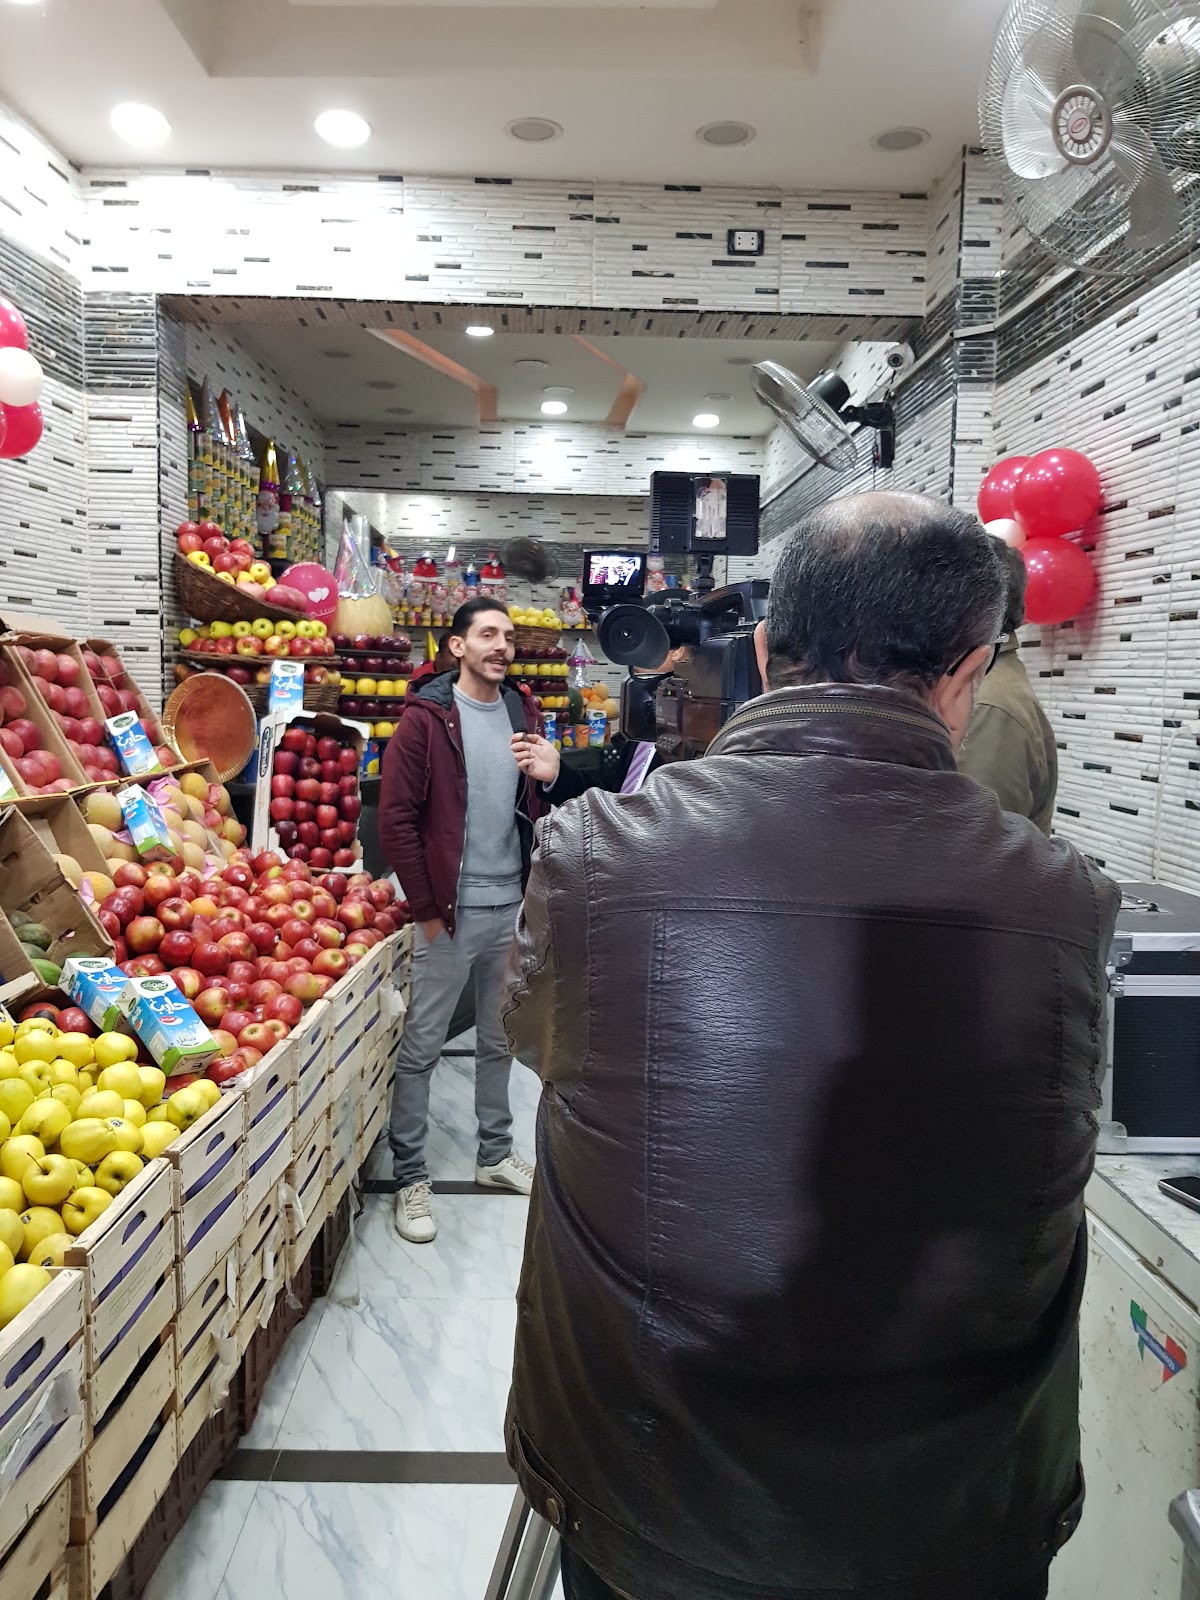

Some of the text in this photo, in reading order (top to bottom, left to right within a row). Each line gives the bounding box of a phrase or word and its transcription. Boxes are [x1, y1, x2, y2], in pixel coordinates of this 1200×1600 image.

[275, 677, 303, 690] حليب
[117, 730, 147, 749] حليب
[87, 971, 129, 986] حليب
[149, 995, 190, 1016] حليب
